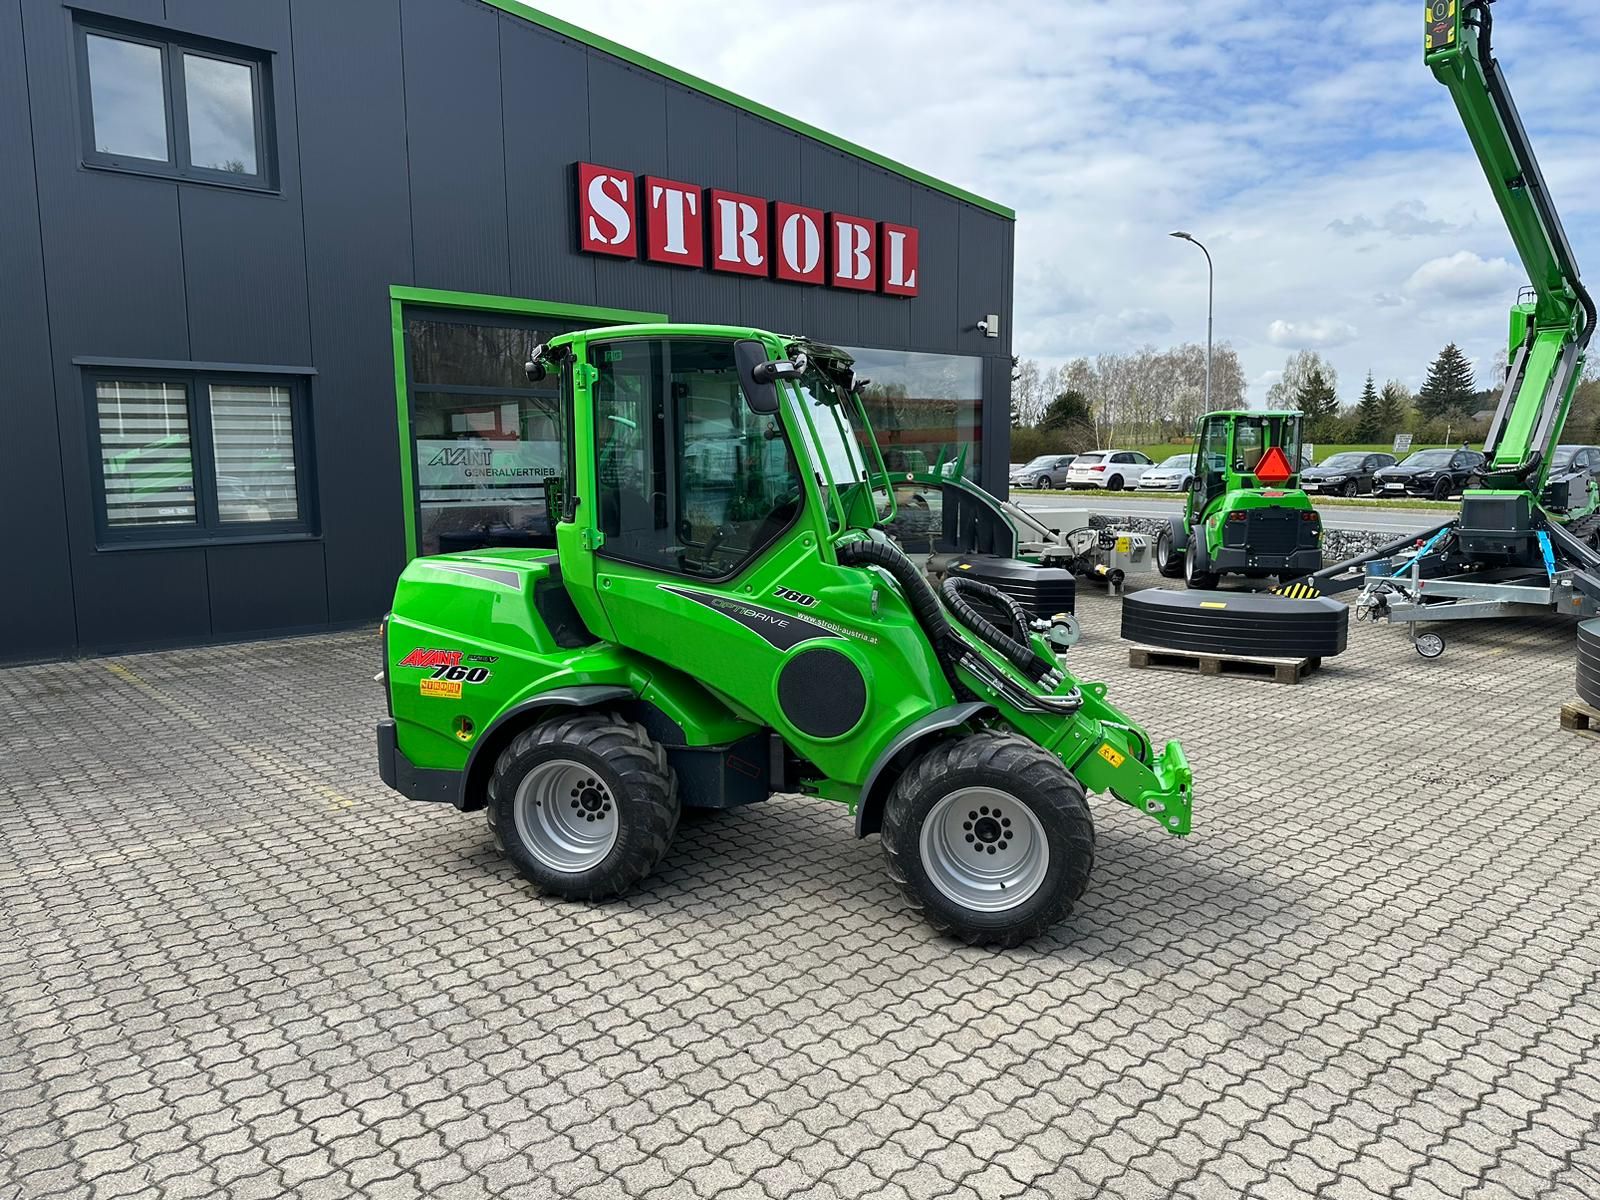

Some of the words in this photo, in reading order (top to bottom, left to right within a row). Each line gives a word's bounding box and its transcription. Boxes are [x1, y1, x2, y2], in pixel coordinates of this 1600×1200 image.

[588, 175, 916, 288] STROBL
[428, 447, 493, 466] AVANT
[464, 467, 556, 478] GENERALVERTRIEB
[711, 598, 790, 628] OPTIDRIVE
[797, 611, 878, 645] www.strobl-austria.at
[398, 648, 463, 668] AVANT
